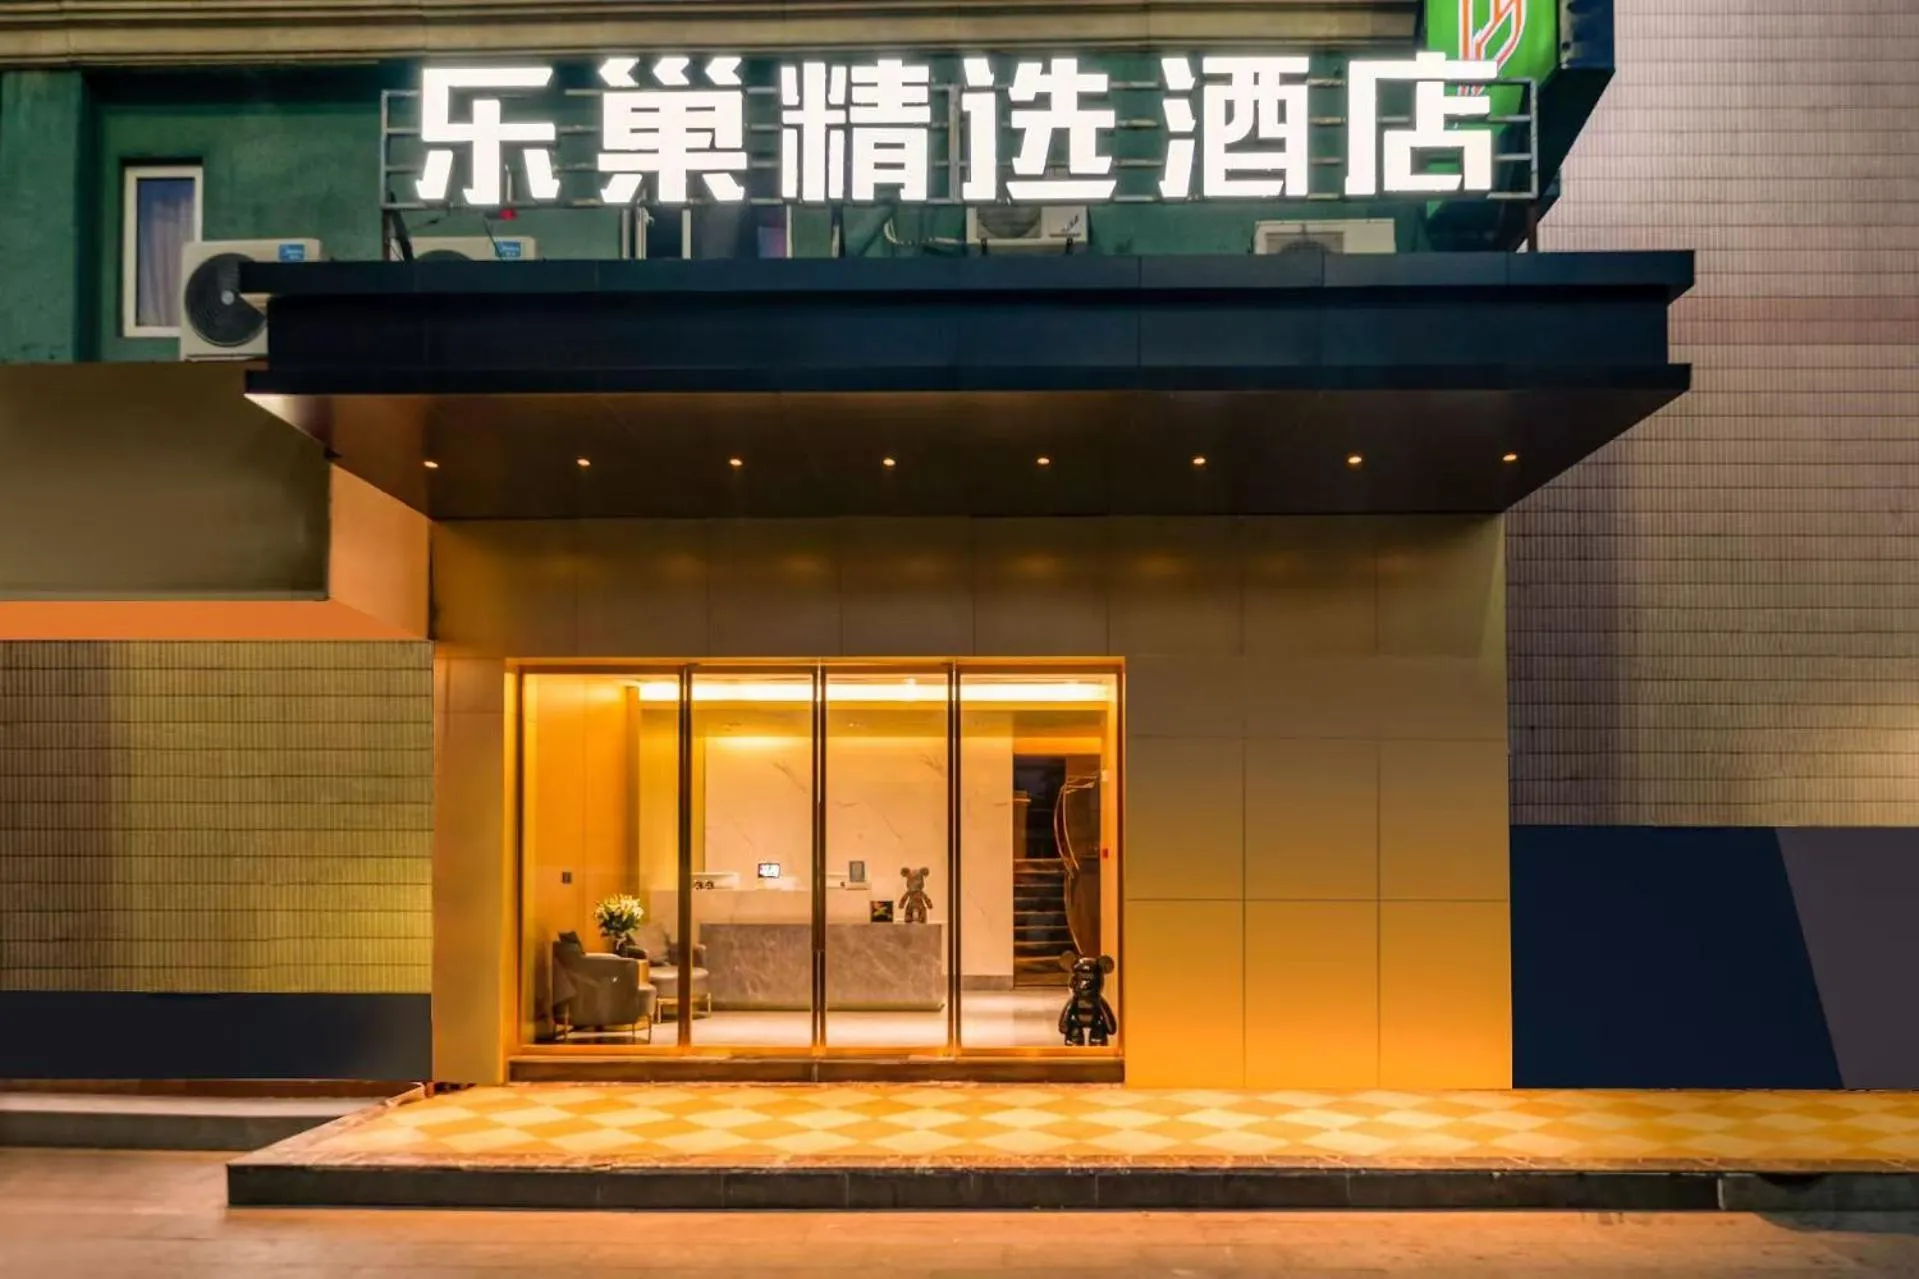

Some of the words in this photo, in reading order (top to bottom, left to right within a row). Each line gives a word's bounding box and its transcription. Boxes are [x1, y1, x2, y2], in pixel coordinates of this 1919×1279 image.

[415, 52, 1498, 205] 乐巢精选酒店
